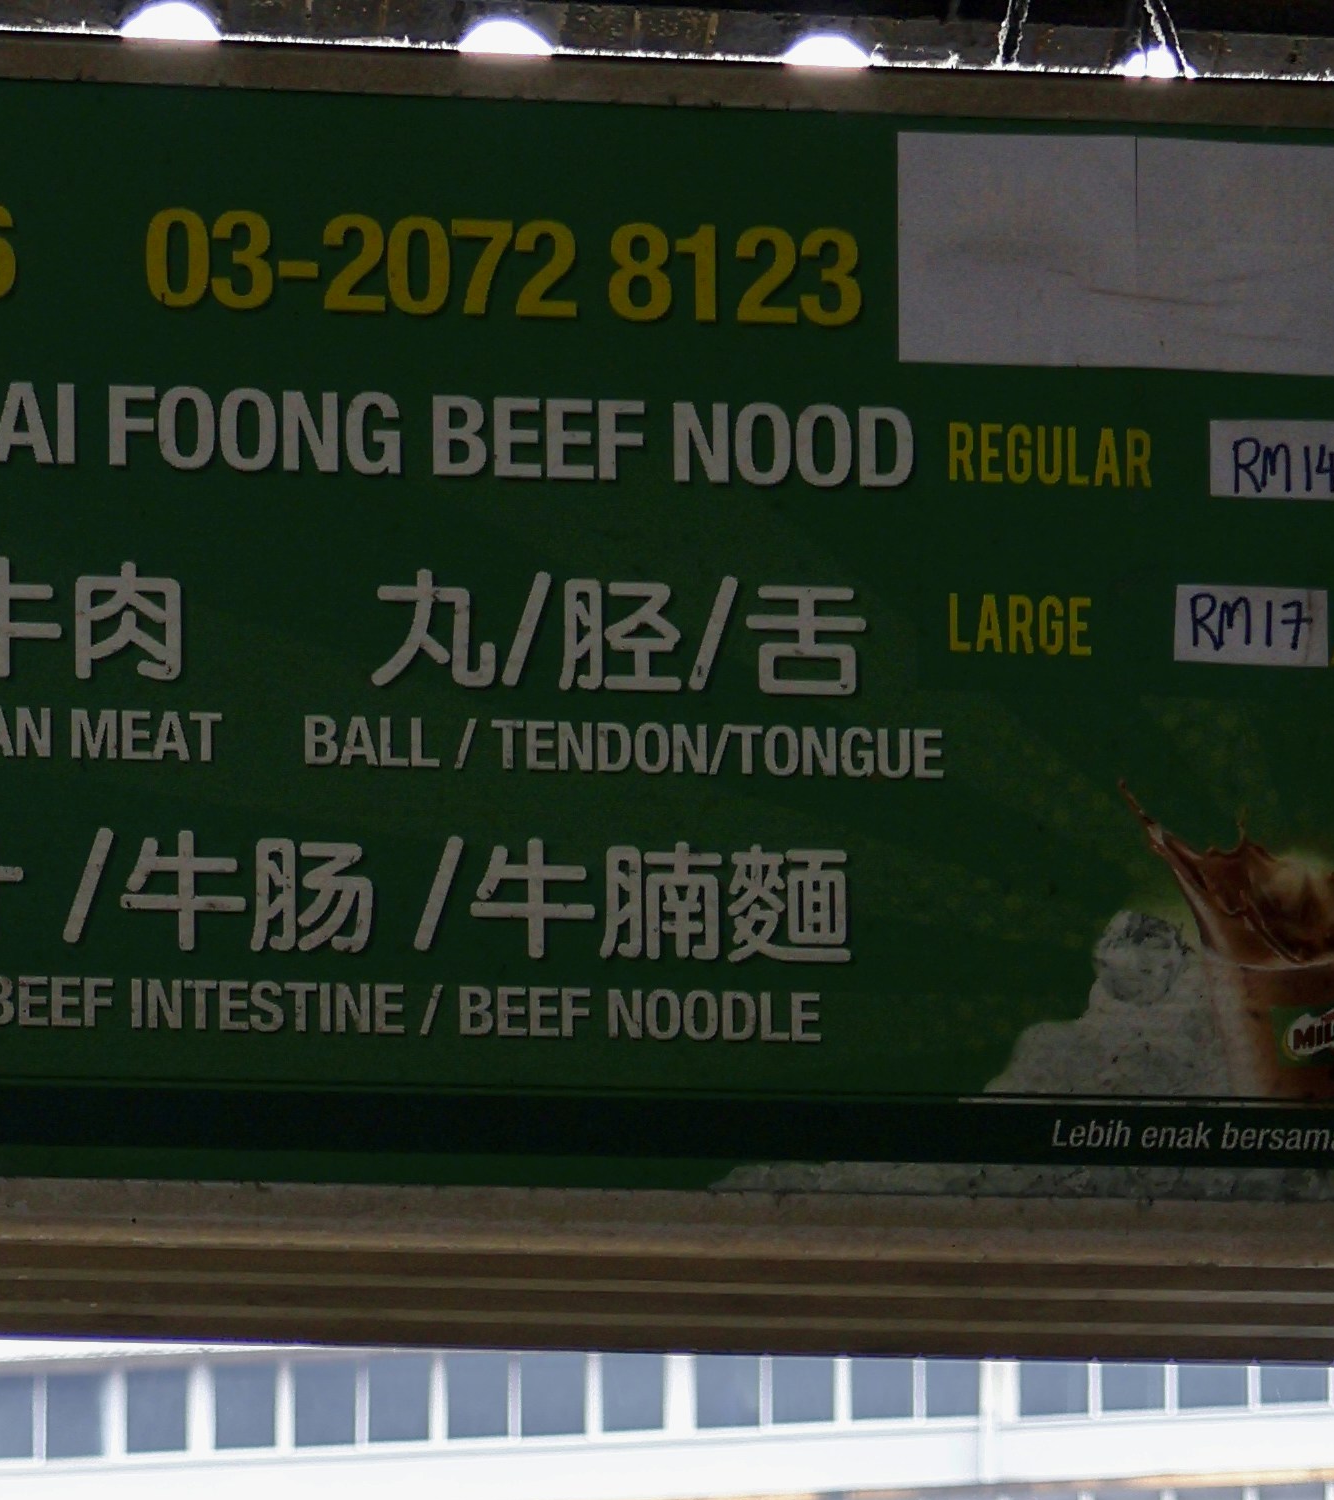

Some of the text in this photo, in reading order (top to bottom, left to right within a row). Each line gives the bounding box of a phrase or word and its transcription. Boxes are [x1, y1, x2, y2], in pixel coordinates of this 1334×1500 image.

[145, 208, 863, 326] 03-2072 8123
[108, 384, 402, 474] FOONG
[432, 394, 645, 480] BEEF
[672, 401, 915, 488] NOOD
[948, 421, 1152, 488] REGULAR
[948, 593, 1092, 657] LARGE
[1189, 591, 1313, 652] RM17
[71, 708, 223, 762] MEAT
[304, 714, 440, 767] BALL
[131, 978, 405, 1034] INTESTINE
[459, 985, 591, 1037] BEEF
[607, 988, 822, 1042] NOODLE
[1051, 1119, 1131, 1148] Lebih
[1141, 1121, 1212, 1149] enak
